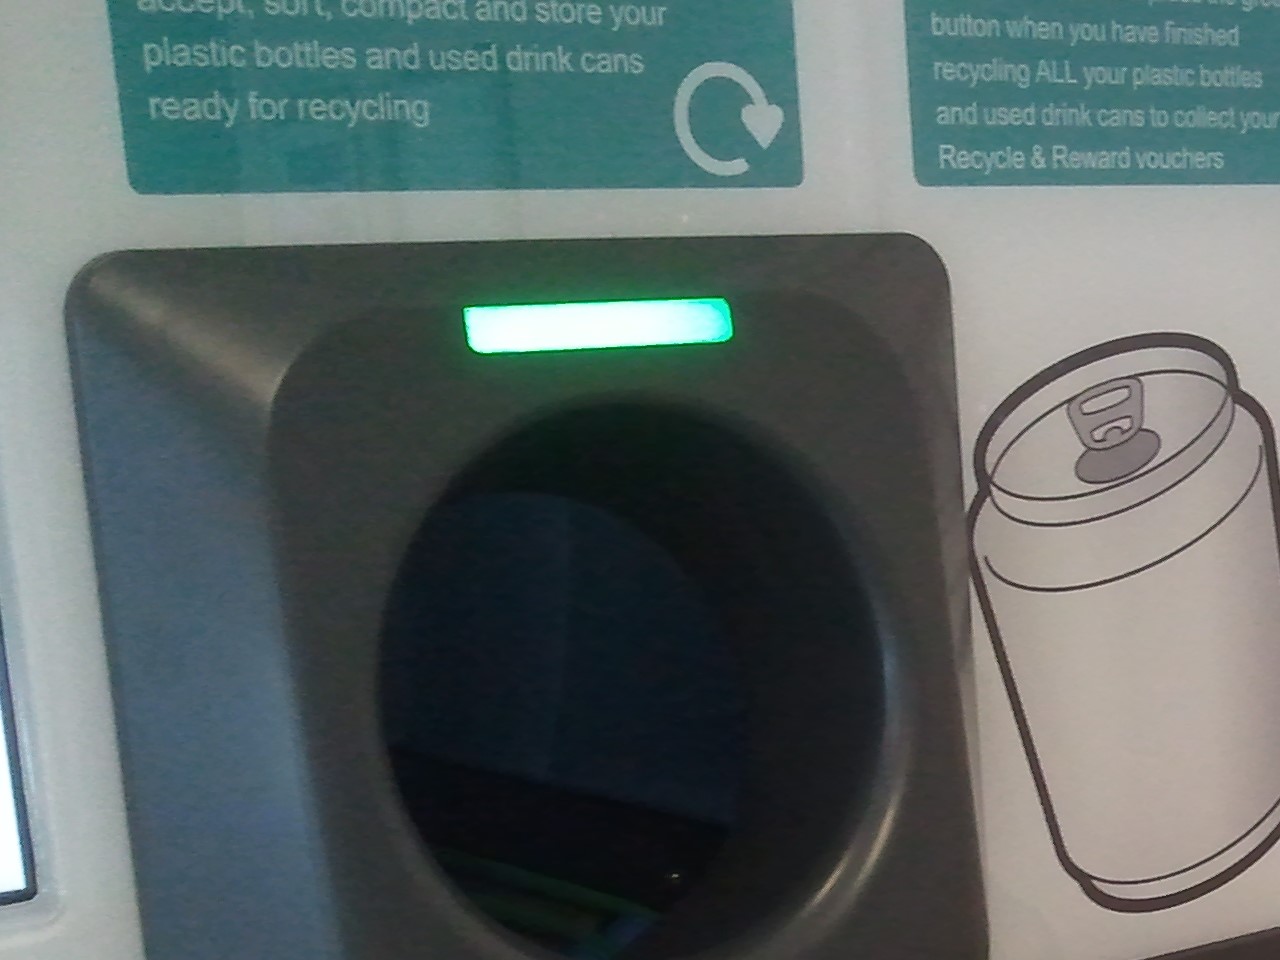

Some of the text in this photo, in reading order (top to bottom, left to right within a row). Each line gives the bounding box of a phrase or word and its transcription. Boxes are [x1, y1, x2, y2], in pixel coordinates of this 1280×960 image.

[341, 0, 469, 23] compact
[476, 0, 527, 24] and
[535, 1, 603, 24] store
[610, 4, 667, 30] your
[931, 12, 1240, 47] button when you have finished
[142, 37, 645, 74] plastic bottles and used drink cans
[933, 58, 1264, 90] recycling ALL your plastic bottles
[148, 90, 430, 128] ready for recycling
[936, 102, 1280, 134] and used drink cans to collect your
[938, 144, 1225, 174] Recycle & Reward vouchers
